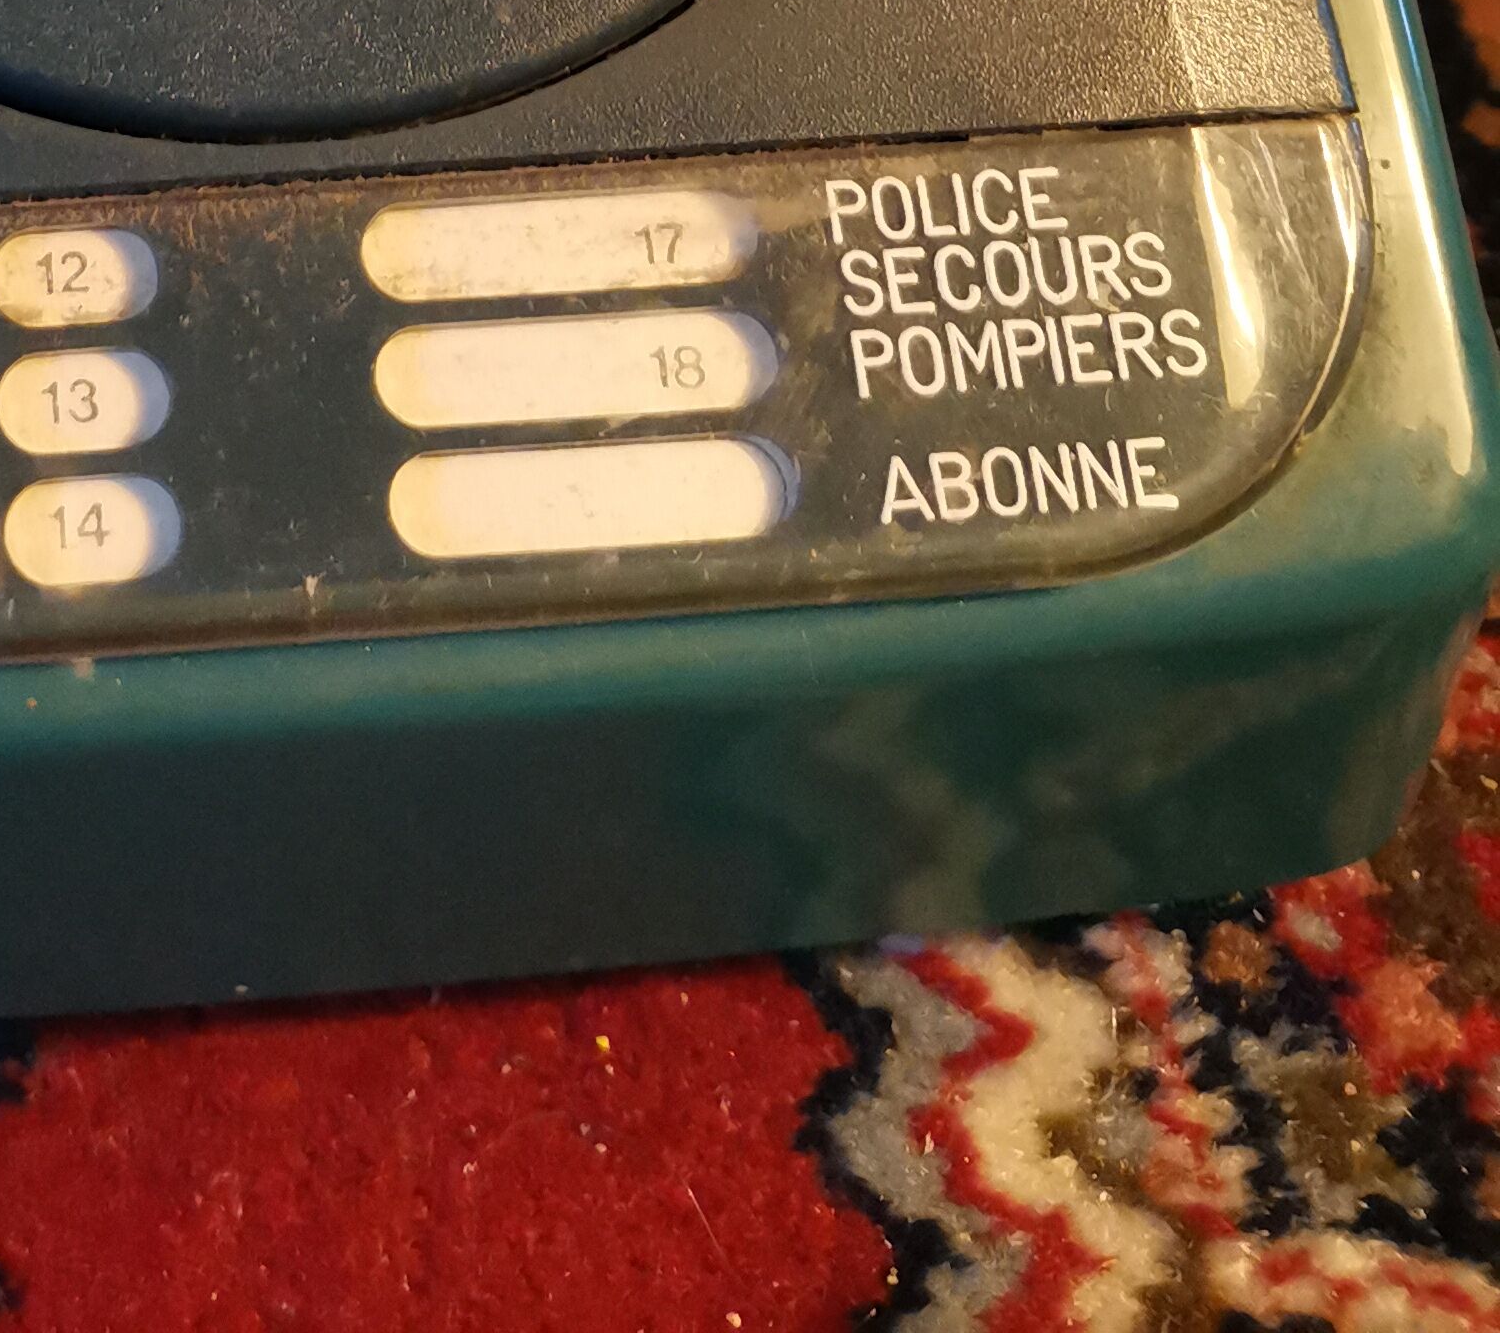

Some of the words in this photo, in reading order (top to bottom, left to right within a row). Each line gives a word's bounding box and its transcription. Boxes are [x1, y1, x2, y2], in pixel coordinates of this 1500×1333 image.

[825, 167, 1069, 244] POLICE
[635, 224, 684, 264] 17
[35, 251, 88, 292] 12
[841, 232, 1172, 317] SECOURS
[651, 347, 706, 389] 18
[853, 309, 1206, 398] POMPIERS
[41, 380, 100, 423] 13
[880, 437, 1179, 523] ABONNE
[51, 505, 111, 550] 14
